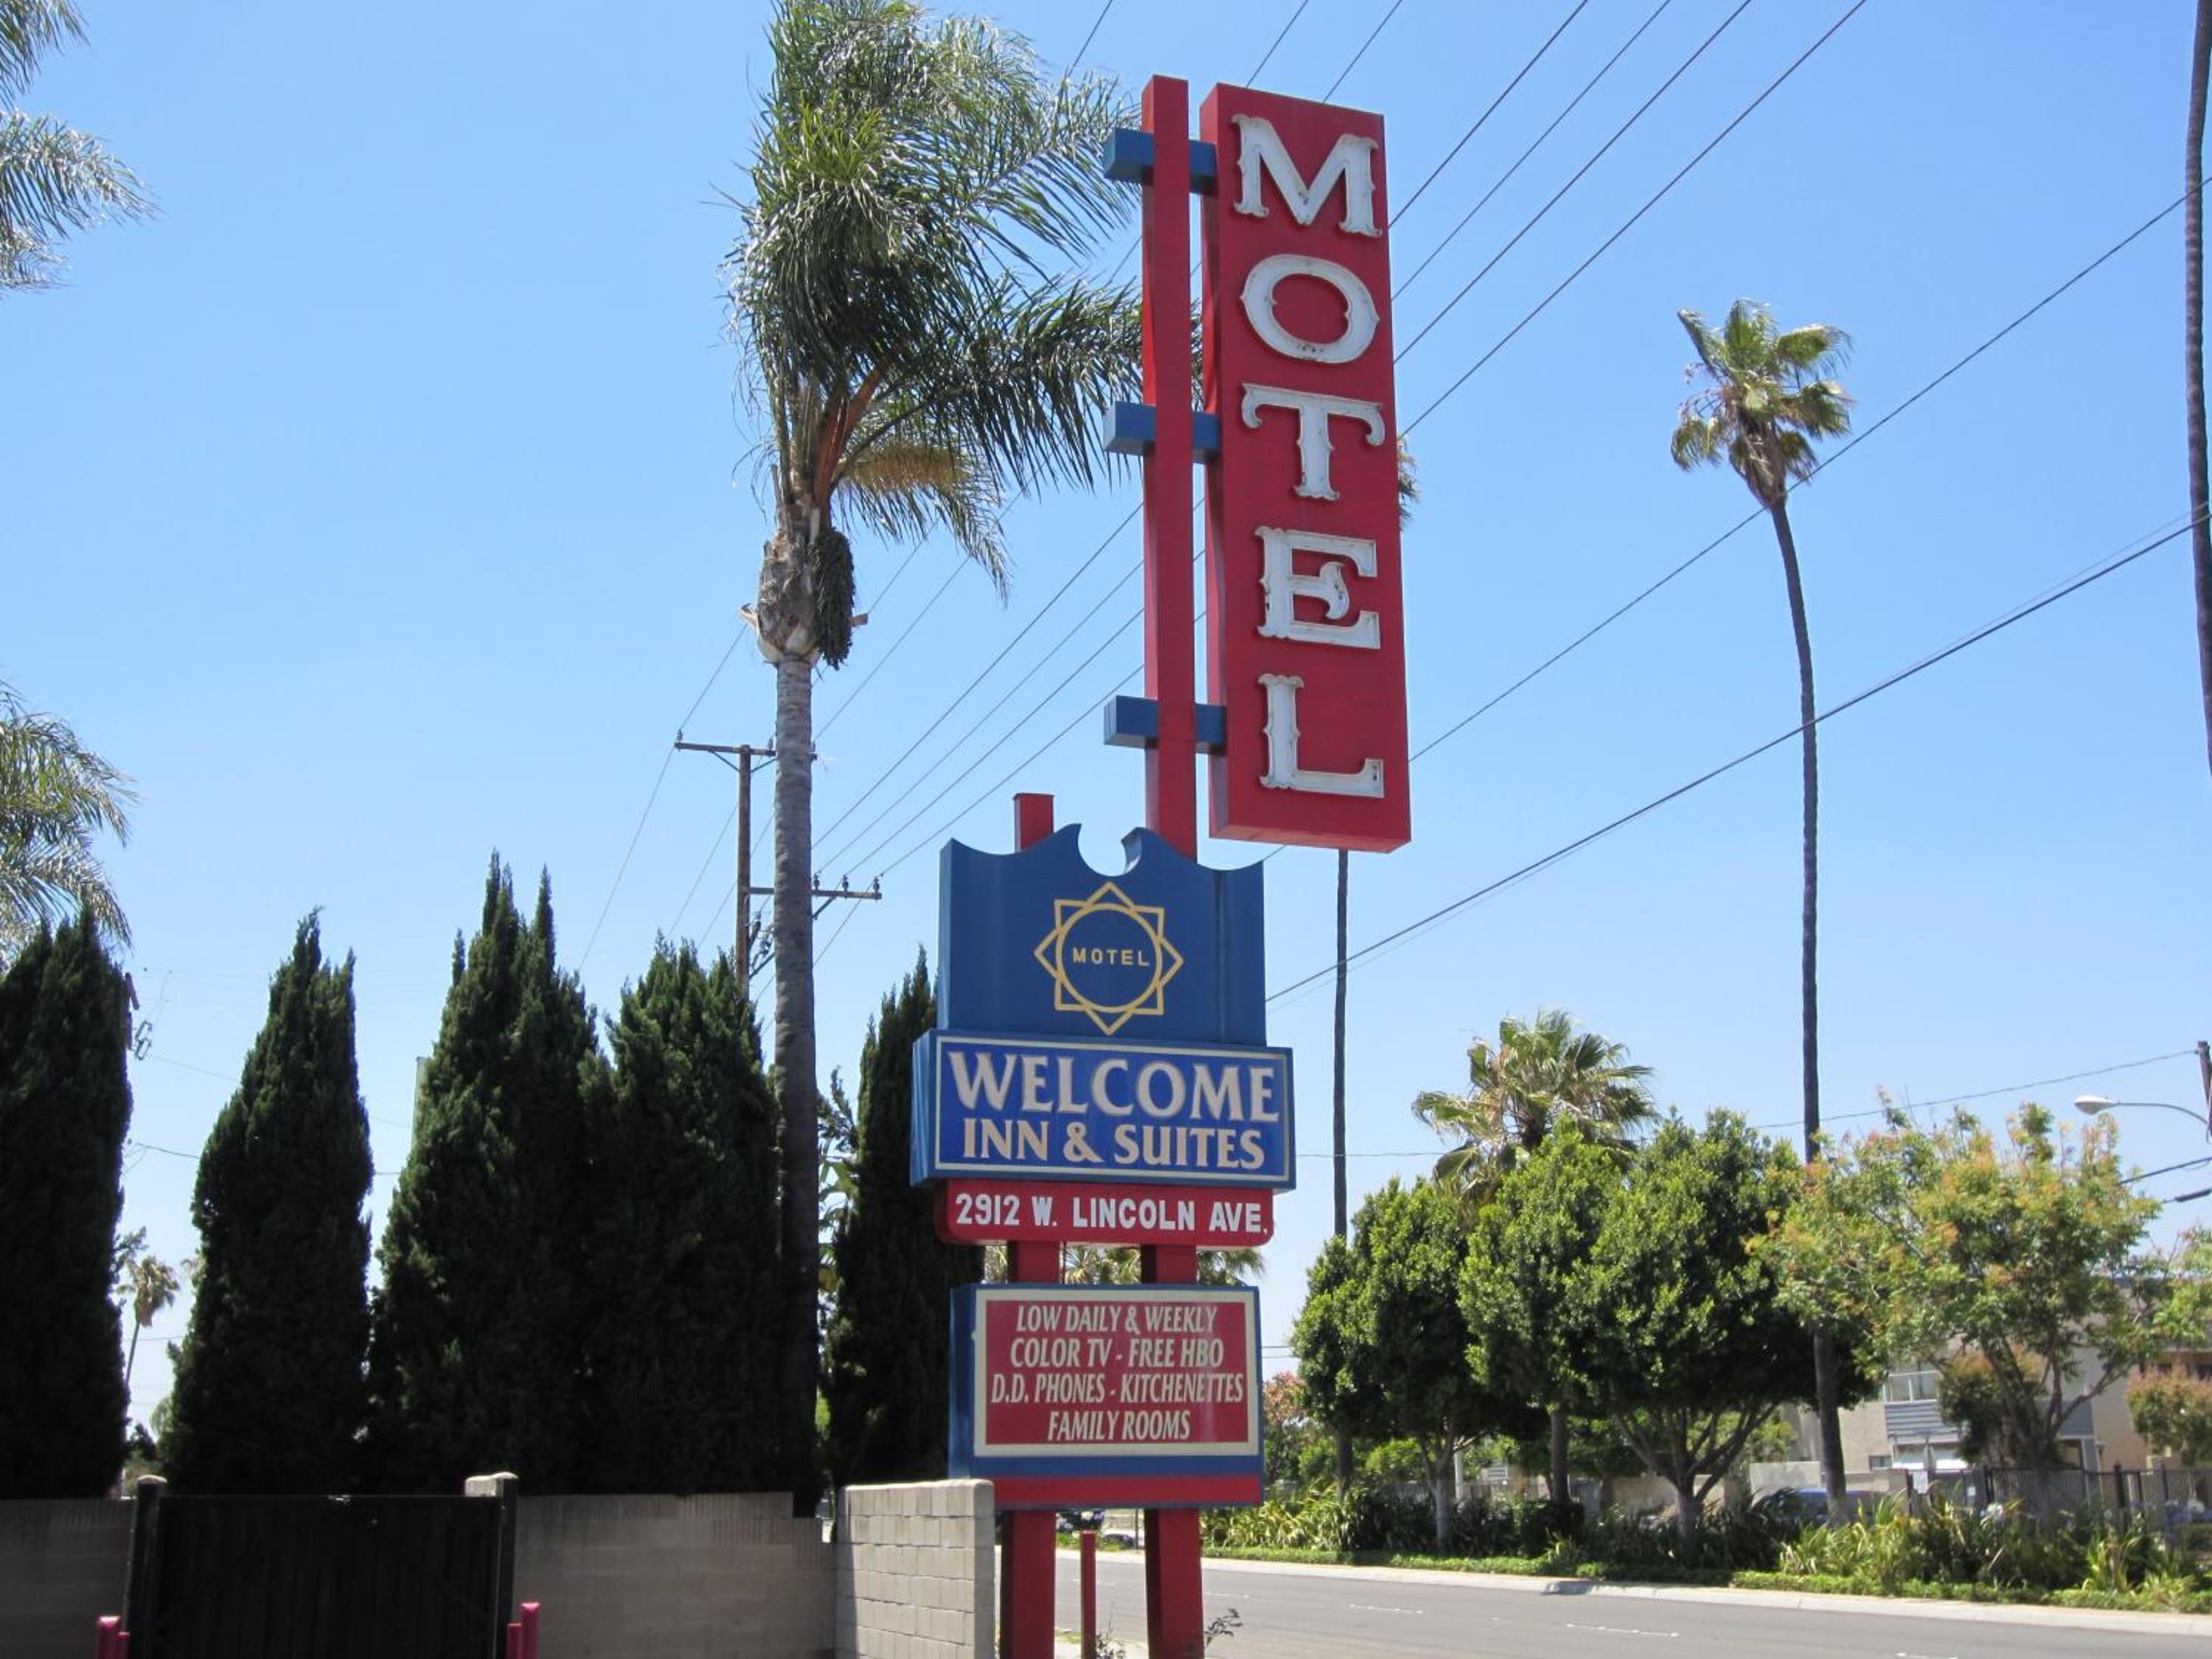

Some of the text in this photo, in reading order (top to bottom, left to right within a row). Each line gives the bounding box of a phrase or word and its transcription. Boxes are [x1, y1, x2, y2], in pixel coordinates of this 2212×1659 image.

[1231, 114, 1385, 799] MOTEL
[1073, 947, 1150, 967] MOTEL
[947, 1051, 1279, 1122] WELCOME
[963, 1118, 1265, 1169] INN & SUITES
[956, 1194, 1020, 1226] 2912
[1032, 1197, 1057, 1227] W.
[1073, 1197, 1195, 1231] LINCOLN
[1016, 1304, 1217, 1335] LOW DAILY & WEEKLY
[1010, 1338, 1080, 1368] COLOR
[1088, 1338, 1112, 1368] TV
[1128, 1338, 1175, 1367] FREE
[1181, 1338, 1224, 1367] HBO
[992, 1373, 1029, 1404] D.D.
[1034, 1373, 1105, 1403] PHONES
[1120, 1374, 1244, 1403] KITCHENETTES
[1048, 1410, 1192, 1441] FAMILY ROOMS
